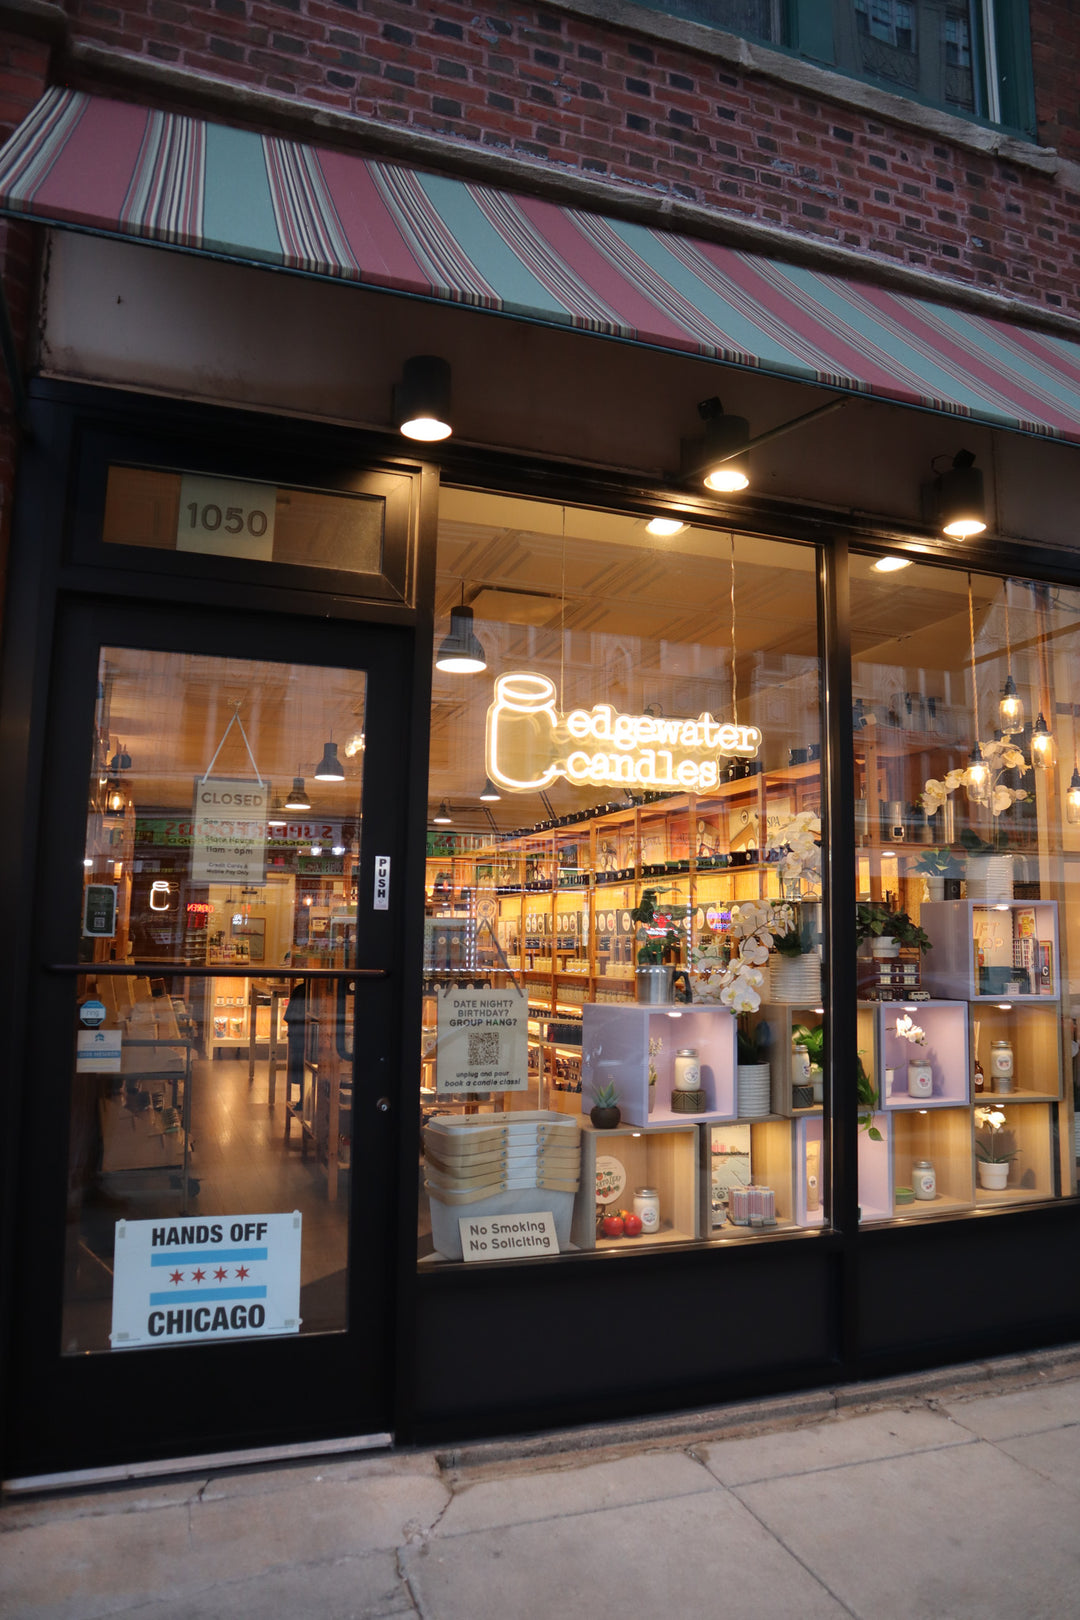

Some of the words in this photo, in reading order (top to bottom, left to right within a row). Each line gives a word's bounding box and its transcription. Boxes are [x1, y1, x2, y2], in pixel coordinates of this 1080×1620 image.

[187, 502, 267, 537] 1050
[567, 704, 758, 751] edgewater
[566, 749, 718, 787] candles
[201, 792, 263, 806] CLOSED
[206, 846, 226, 854] 11am
[234, 848, 252, 856] 6pm
[377, 858, 387, 898] PUSH
[454, 1000, 478, 1008] DATE
[480, 1000, 514, 1008] NIGHT?
[458, 1009, 510, 1017] BIRTHDAY?
[450, 1019, 483, 1027] GROUP
[486, 1018, 518, 1026] HANG?
[500, 1078, 520, 1086] class!
[152, 1224, 223, 1246] HANDS
[230, 1222, 268, 1242] OFF
[470, 1224, 488, 1236] No
[492, 1221, 546, 1234] Smoking
[470, 1240, 488, 1251] No
[492, 1236, 550, 1249] Soliciting
[147, 1304, 266, 1336] CHICAGO
